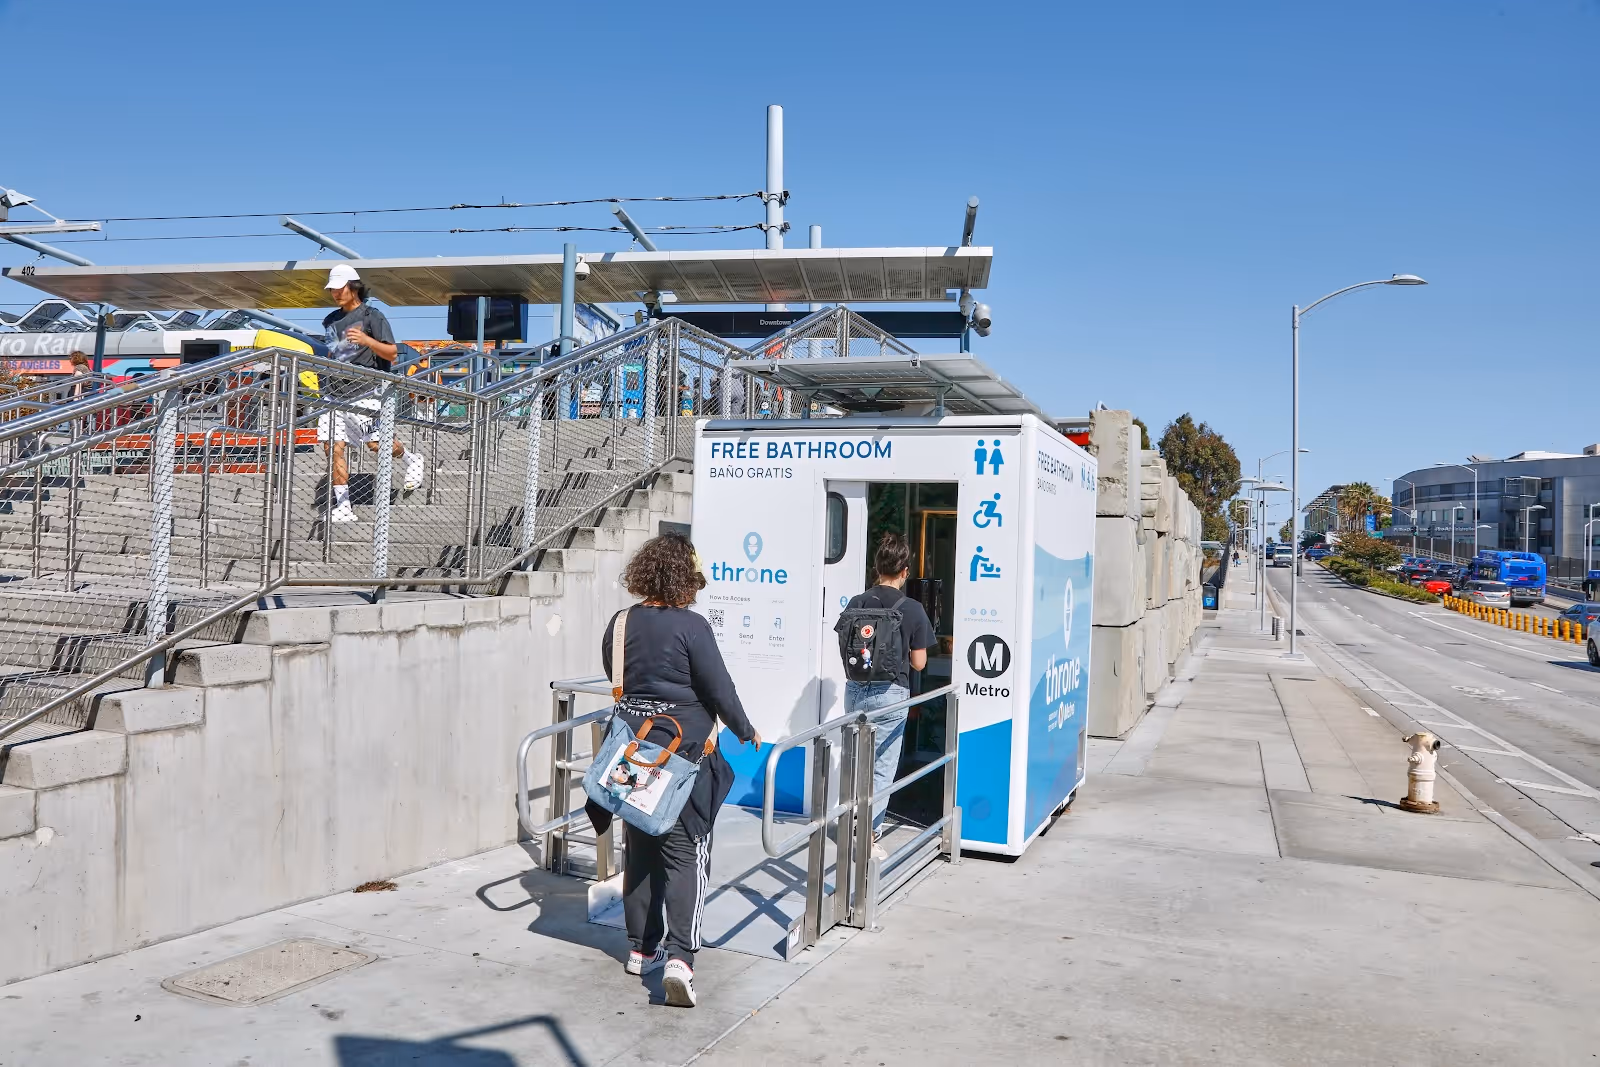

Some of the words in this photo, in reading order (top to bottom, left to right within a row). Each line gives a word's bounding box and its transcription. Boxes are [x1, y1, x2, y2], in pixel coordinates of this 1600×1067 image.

[21, 266, 35, 276] 402
[0, 335, 27, 356] ro
[33, 333, 84, 356] Rail
[20, 360, 61, 370] ANGELES
[711, 442, 760, 459] FREE
[766, 441, 892, 459] BATHROOM
[710, 464, 744, 479] BAÑO
[747, 467, 793, 479] GRATIS
[1038, 450, 1050, 473] FREE
[711, 561, 788, 584] throne
[975, 642, 1003, 671] M
[1045, 653, 1080, 706] throne
[965, 682, 1010, 698] Metro
